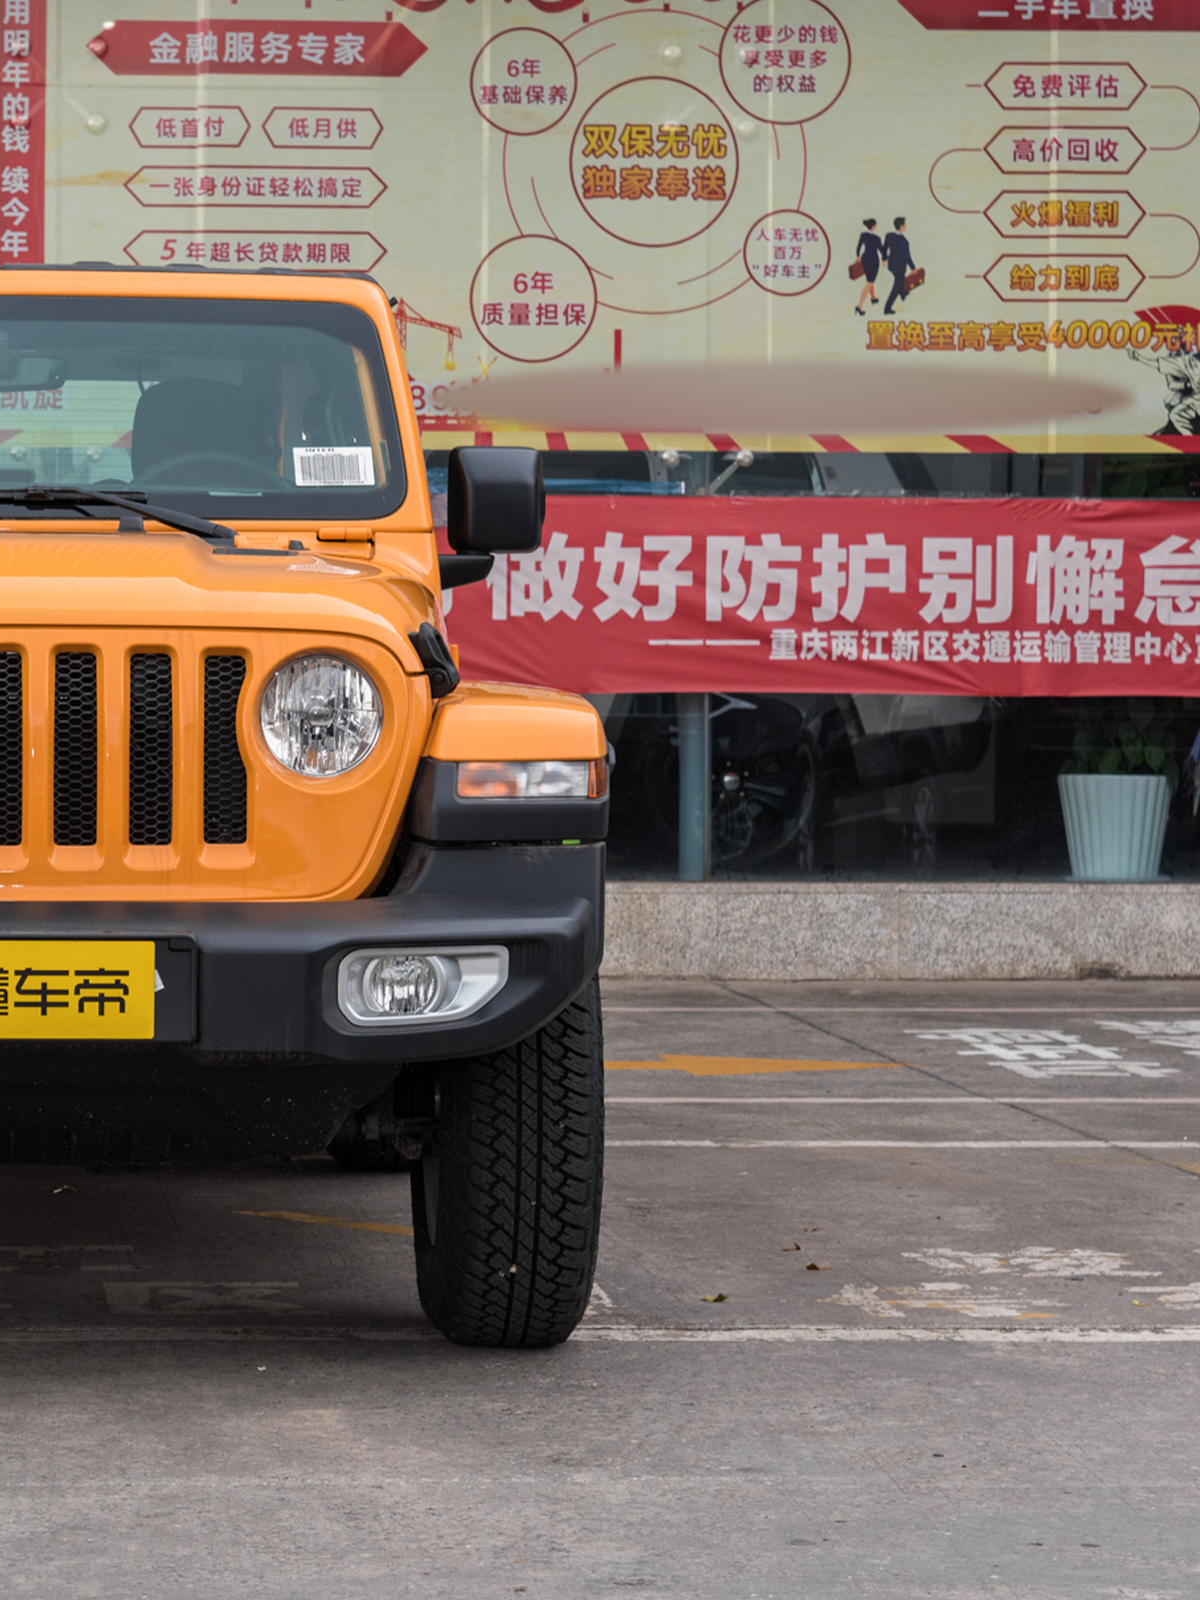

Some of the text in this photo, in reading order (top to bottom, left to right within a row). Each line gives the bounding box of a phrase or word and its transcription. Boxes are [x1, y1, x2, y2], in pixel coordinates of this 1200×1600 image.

[732, 25, 839, 45] 花更少的钱
[148, 31, 366, 66] 金融服务专家
[742, 49, 828, 69] 享受更多
[507, 59, 541, 79] 6年
[479, 85, 568, 105] 基础保养
[753, 75, 817, 94] 的权益
[1011, 74, 1120, 99] 免费评估
[155, 116, 225, 139] 低首付
[288, 117, 358, 140] 低月供
[582, 123, 728, 159] 双保无忧
[1011, 138, 1120, 163] 高价回收
[148, 175, 363, 199] 一张身份证轻松搞定
[582, 165, 727, 201] 独家奉送
[1010, 201, 1120, 228] 火爆福利
[756, 228, 819, 242] 人车无忧
[773, 246, 804, 261] 百万
[513, 271, 555, 295] 6年
[1009, 265, 1120, 292] 给力到底
[480, 302, 587, 327] 质量担保
